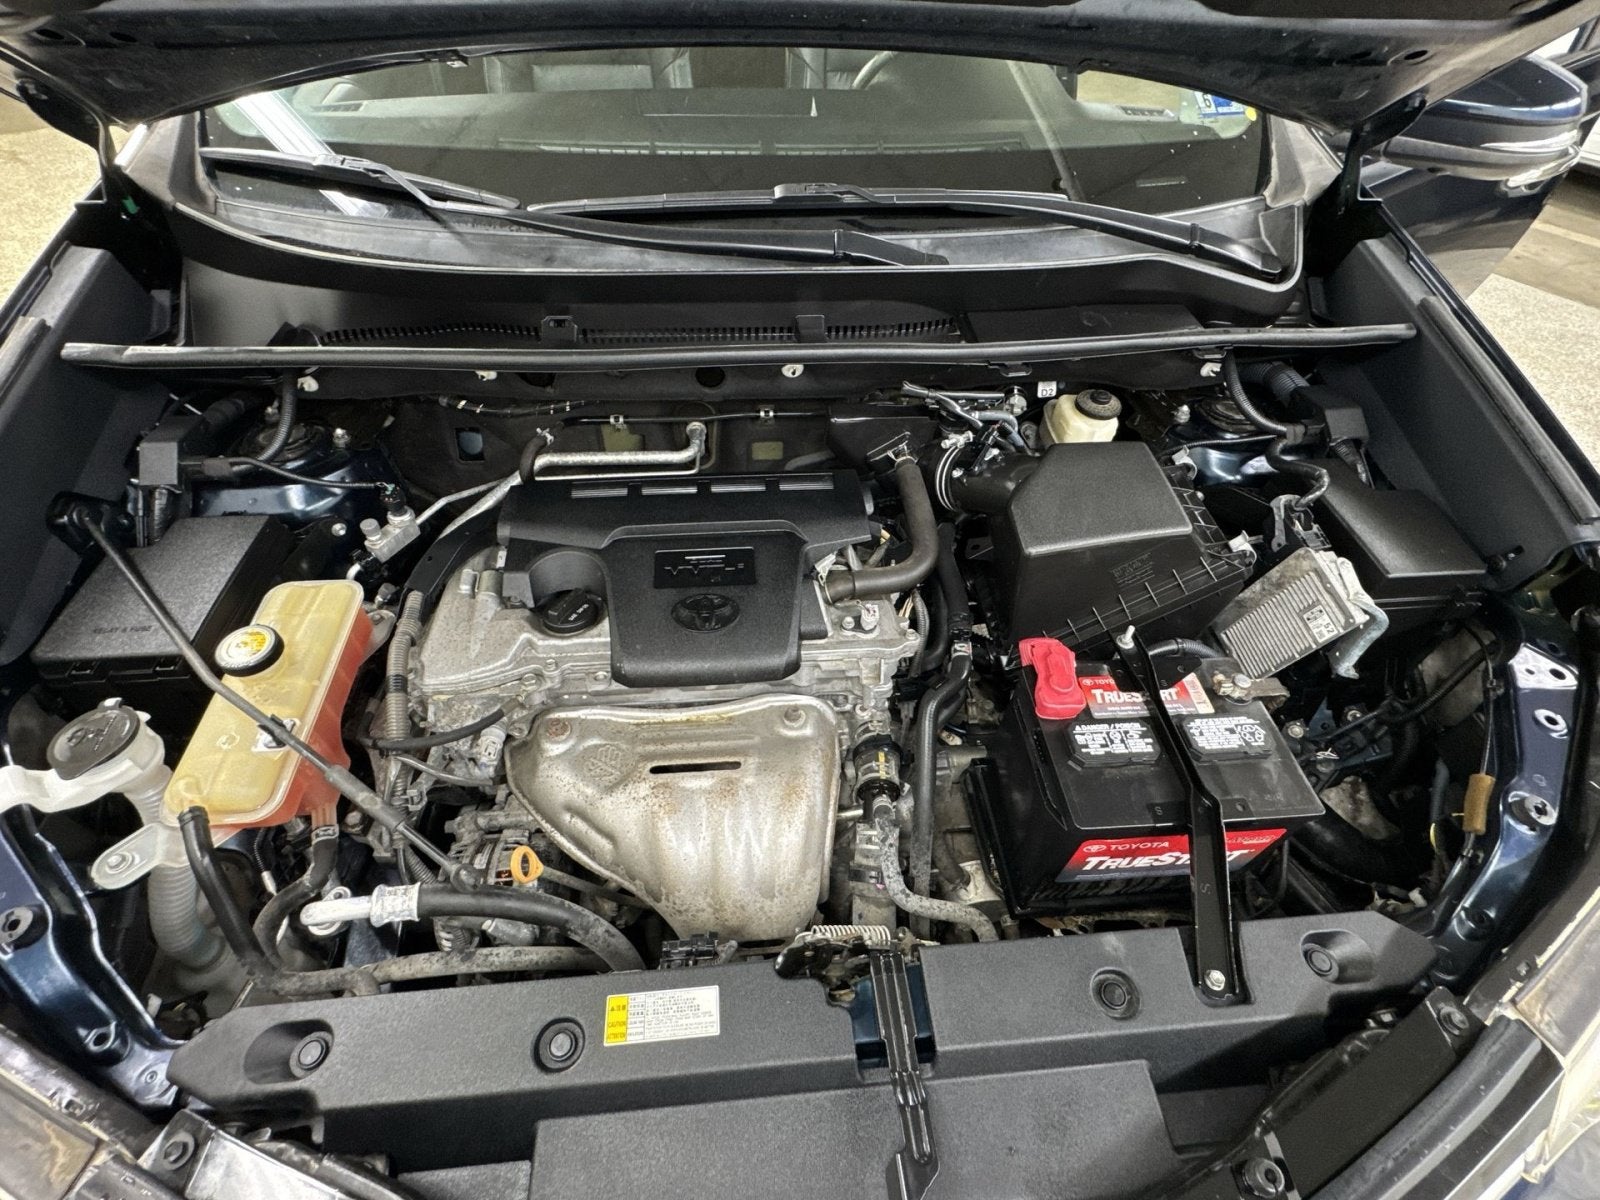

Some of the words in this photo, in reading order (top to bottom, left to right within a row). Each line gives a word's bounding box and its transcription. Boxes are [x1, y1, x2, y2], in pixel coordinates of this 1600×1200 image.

[1041, 389, 1054, 397] D2
[1323, 622, 1335, 635] 52
[1091, 688, 1178, 704] TRUESRT
[1110, 841, 1169, 851] TOYOTA
[1082, 850, 1249, 871] TRUESTT
